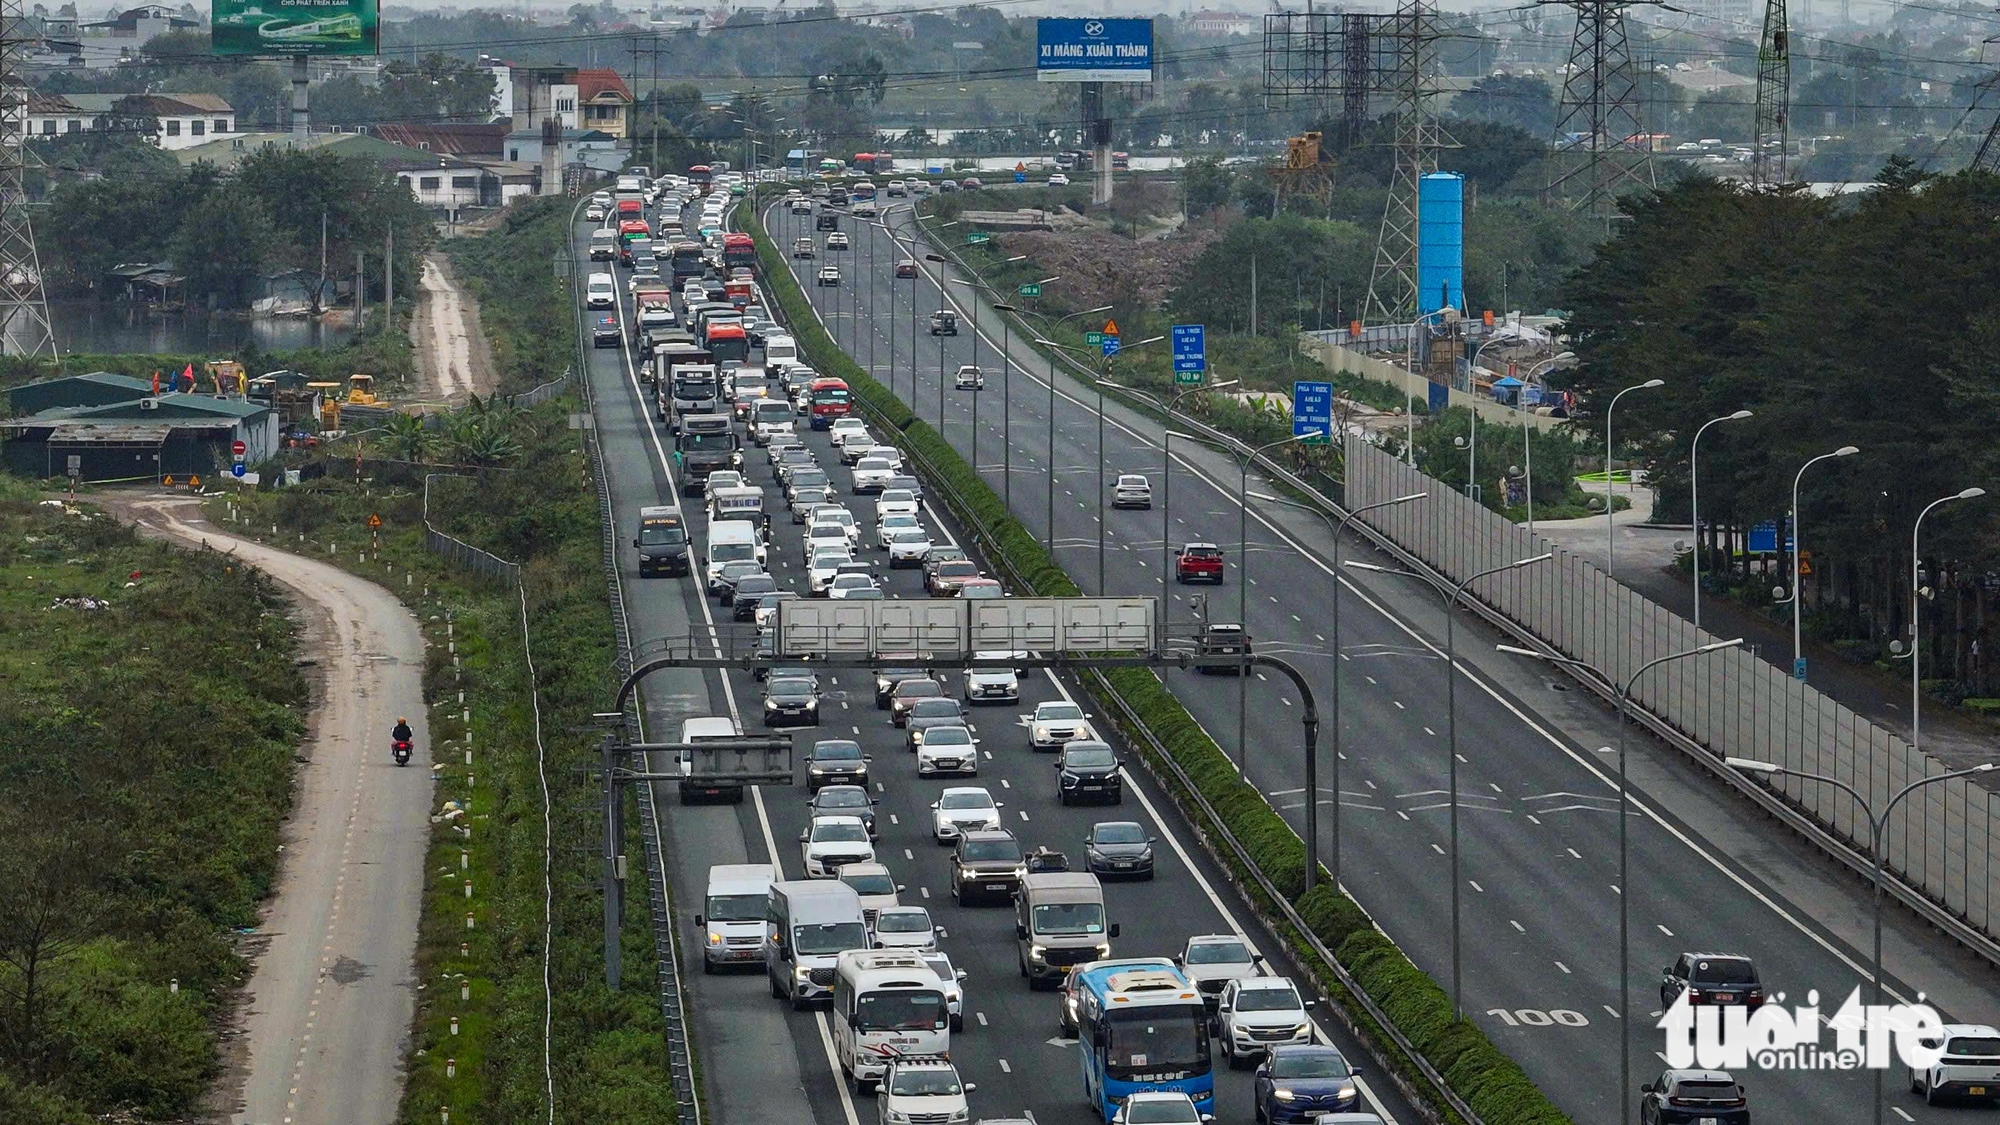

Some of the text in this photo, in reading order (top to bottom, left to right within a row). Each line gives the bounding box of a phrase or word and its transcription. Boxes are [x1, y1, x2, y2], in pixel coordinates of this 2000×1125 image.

[1041, 42, 1147, 57] XI MĂNG XUÂN THÀNH
[1088, 335, 1100, 343] 200
[1487, 1008, 1590, 1027] 100
